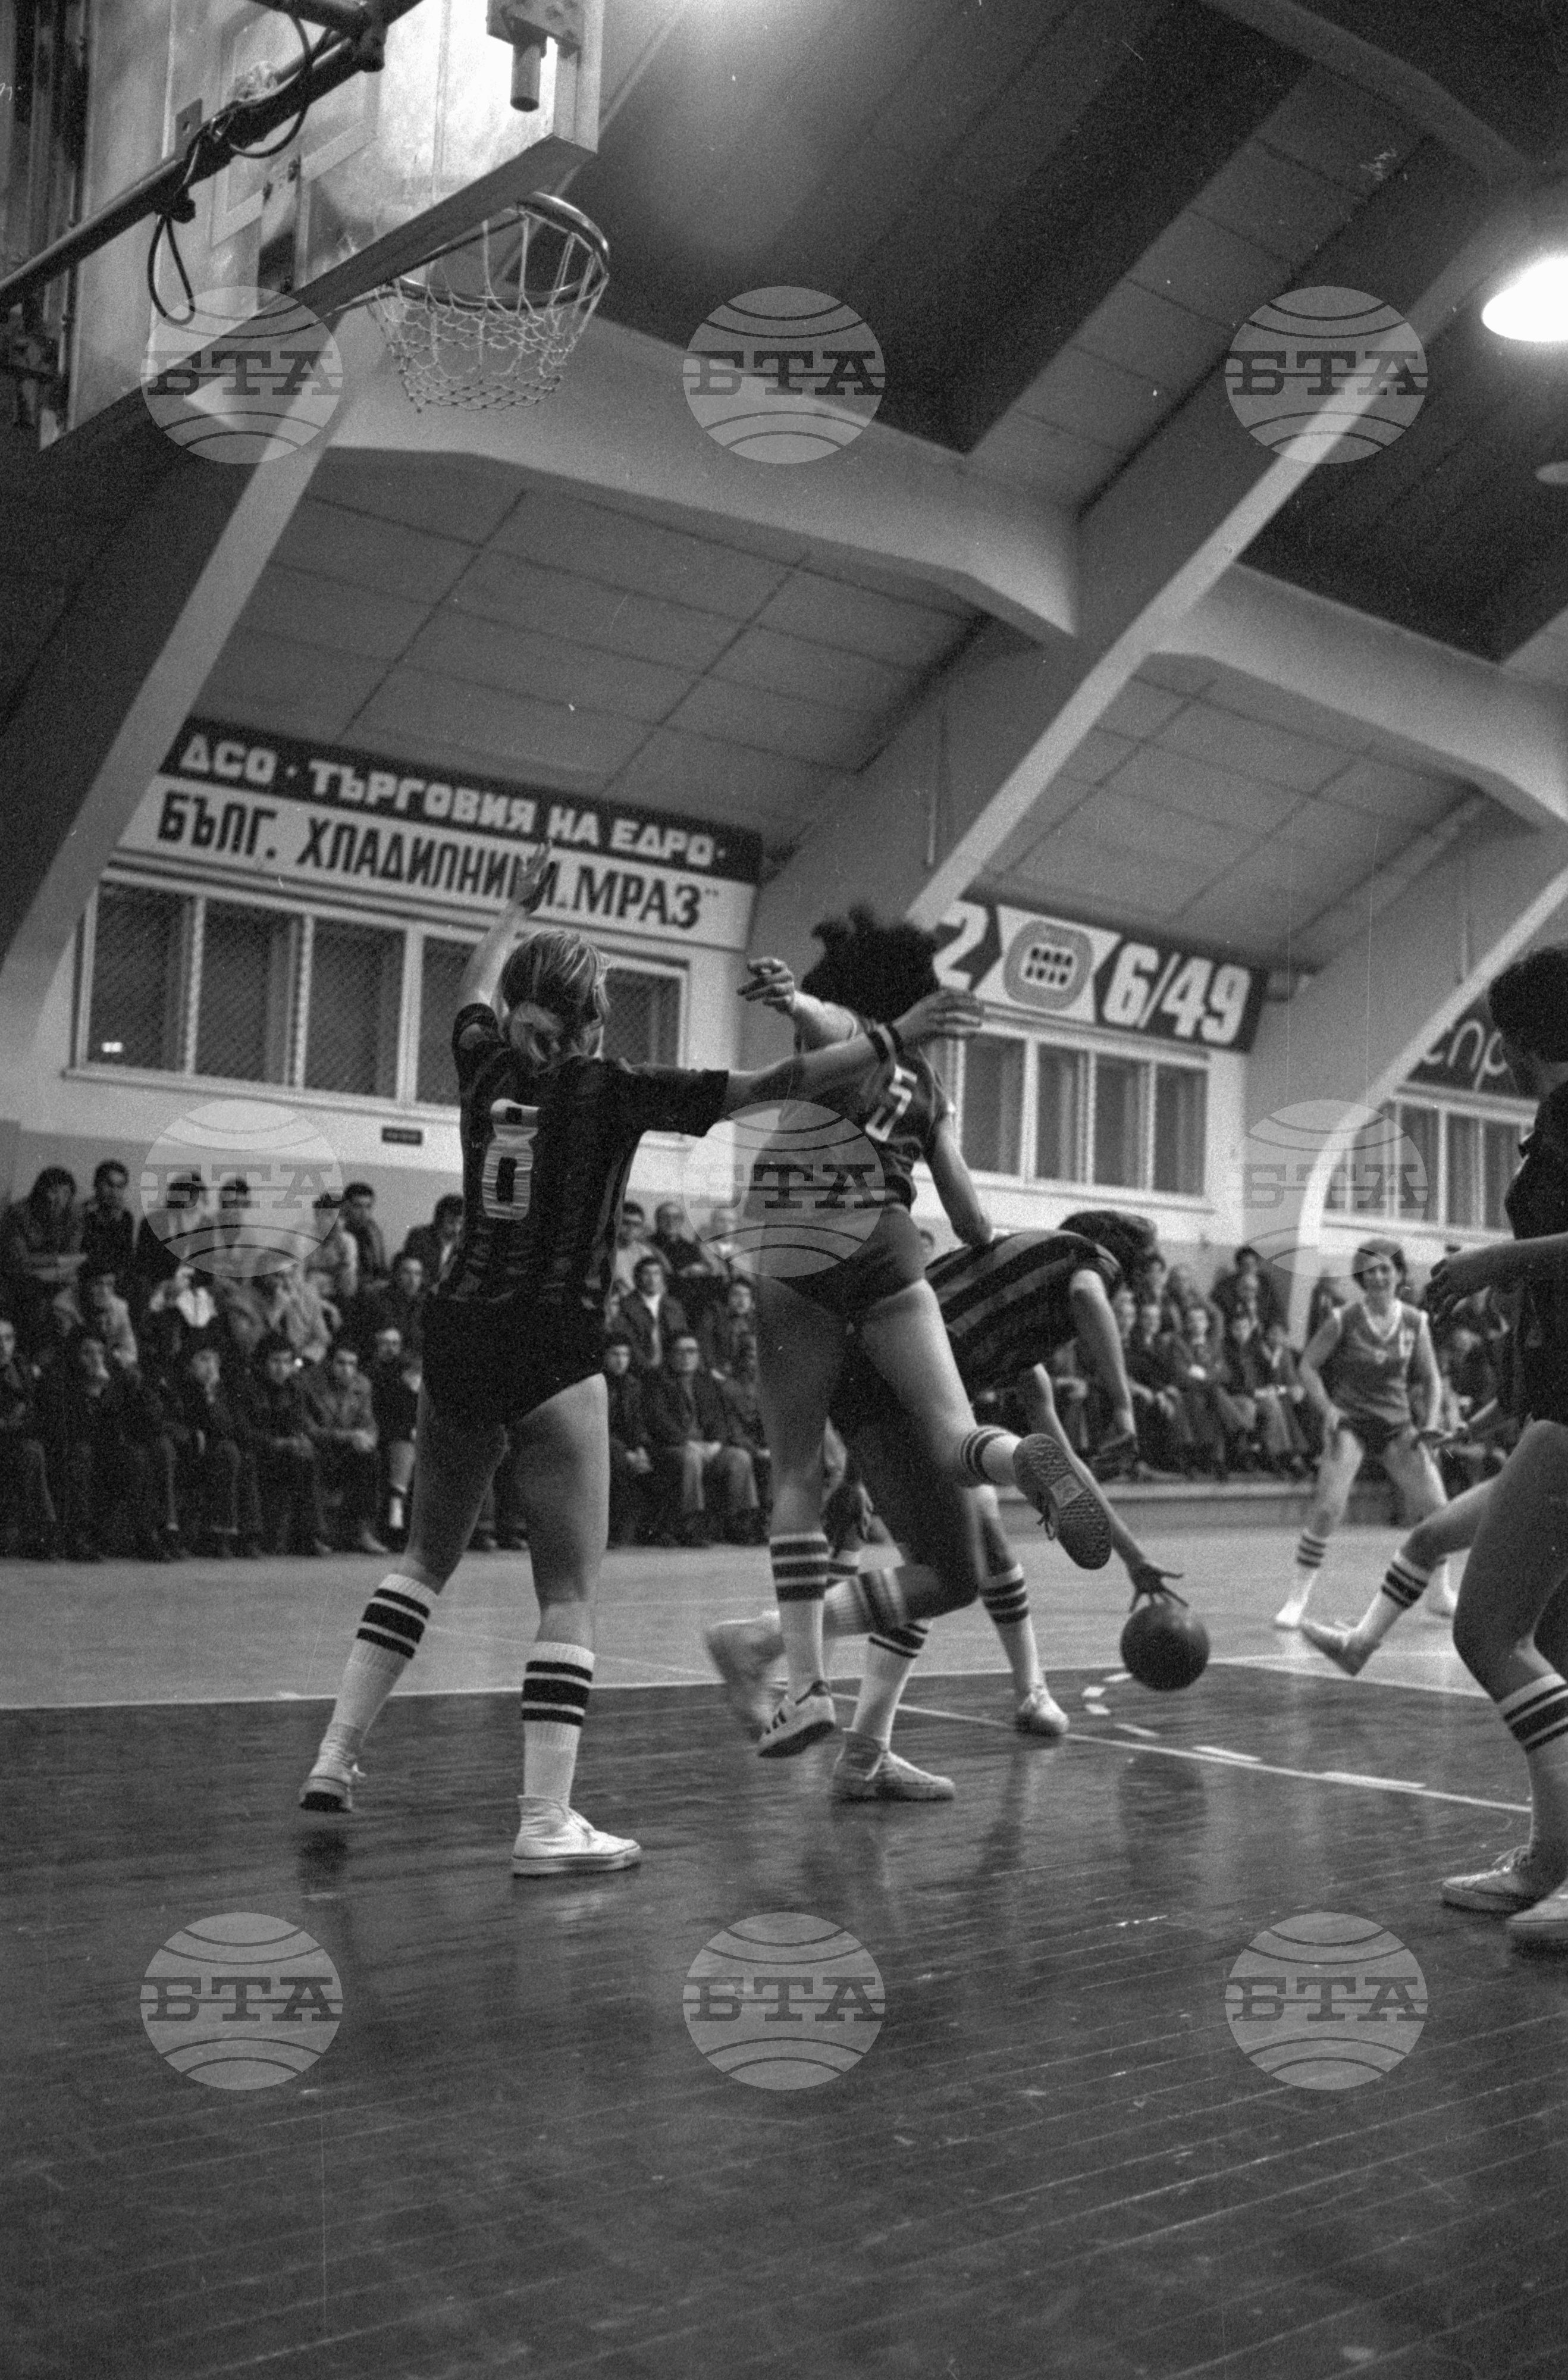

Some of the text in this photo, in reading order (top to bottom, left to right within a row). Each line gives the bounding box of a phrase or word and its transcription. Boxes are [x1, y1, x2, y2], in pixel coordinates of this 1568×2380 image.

[309, 759, 535, 832] ТЪРГОВИЯ
[548, 806, 599, 845] НА
[611, 818, 714, 866] ЕДРО
[932, 900, 989, 991] 2
[1103, 941, 1250, 1044] 6/49
[481, 1098, 540, 1220] 8
